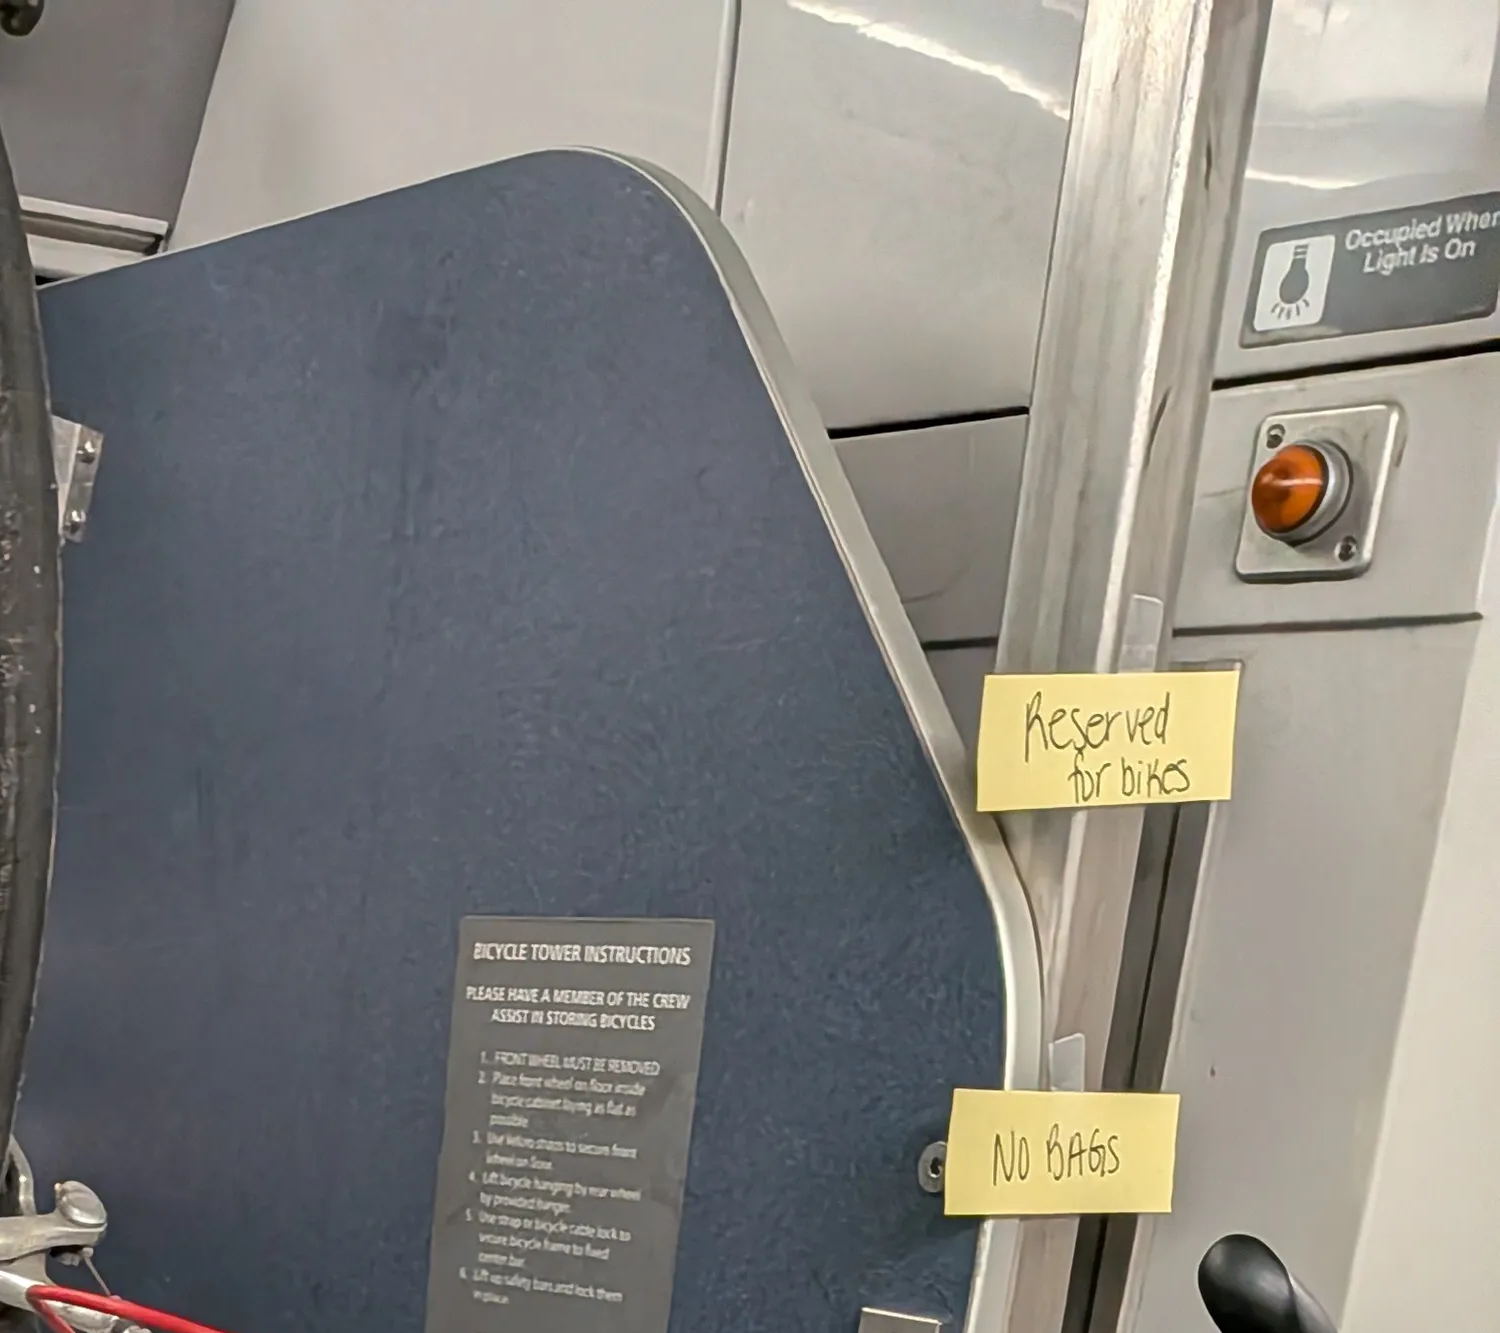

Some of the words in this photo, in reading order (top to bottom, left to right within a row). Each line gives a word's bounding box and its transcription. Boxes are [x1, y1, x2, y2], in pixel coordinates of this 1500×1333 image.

[1345, 214, 1442, 250] Occupied
[1363, 247, 1417, 276] Light
[1419, 244, 1439, 264] Is
[1444, 238, 1476, 260] On
[1024, 691, 1170, 763] Reserved
[1067, 748, 1112, 804] for
[1121, 757, 1190, 798] bikes
[473, 942, 528, 961] BICYCLE
[531, 944, 581, 962] TOWER
[584, 945, 691, 966] INSTRUCTIONS
[466, 986, 506, 1001] PLEASE
[508, 988, 539, 1002] HAVE
[540, 989, 551, 1003] A
[553, 989, 604, 1006] MEMBER
[606, 991, 624, 1006] OF
[626, 992, 650, 1007] THE
[652, 993, 691, 1009] CREW
[491, 1008, 529, 1024] ASSIST
[530, 1010, 543, 1024] IN
[546, 1010, 597, 1028] STORING
[600, 1013, 656, 1030] BICYCLES
[993, 1128, 1030, 1186] NO
[1046, 1123, 1120, 1181] BAGS
